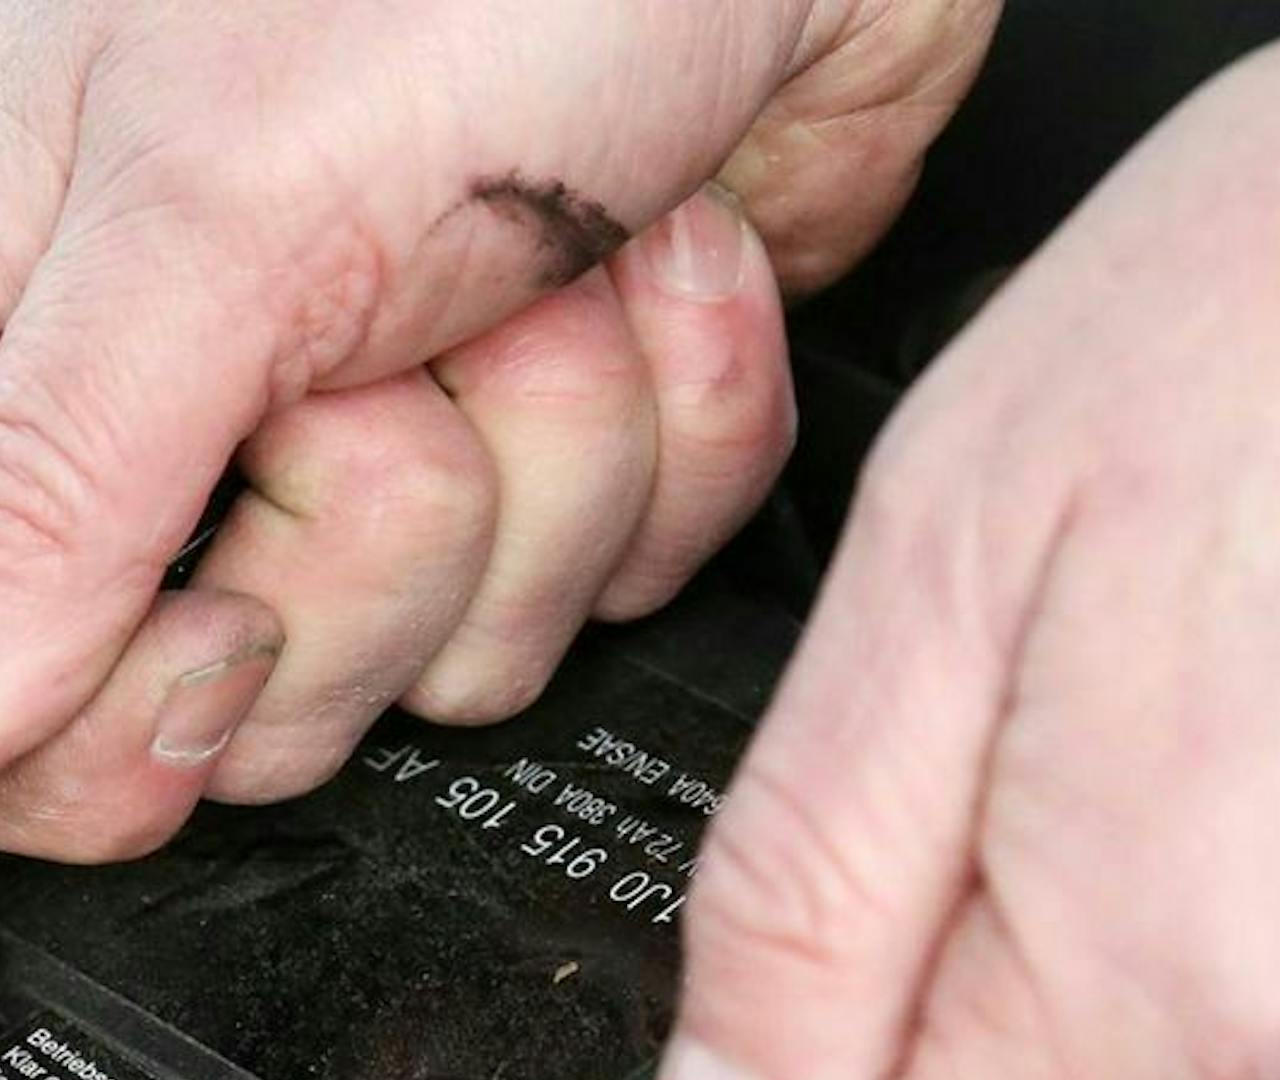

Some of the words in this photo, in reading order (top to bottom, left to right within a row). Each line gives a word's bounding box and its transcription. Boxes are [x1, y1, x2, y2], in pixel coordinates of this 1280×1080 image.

[364, 743, 440, 782] AF
[504, 756, 558, 795] DIN
[434, 775, 517, 830] 105
[553, 782, 618, 826] 380A
[520, 824, 608, 879] 915
[609, 870, 687, 923] 1J0
[1, 1045, 48, 1080] Klar
